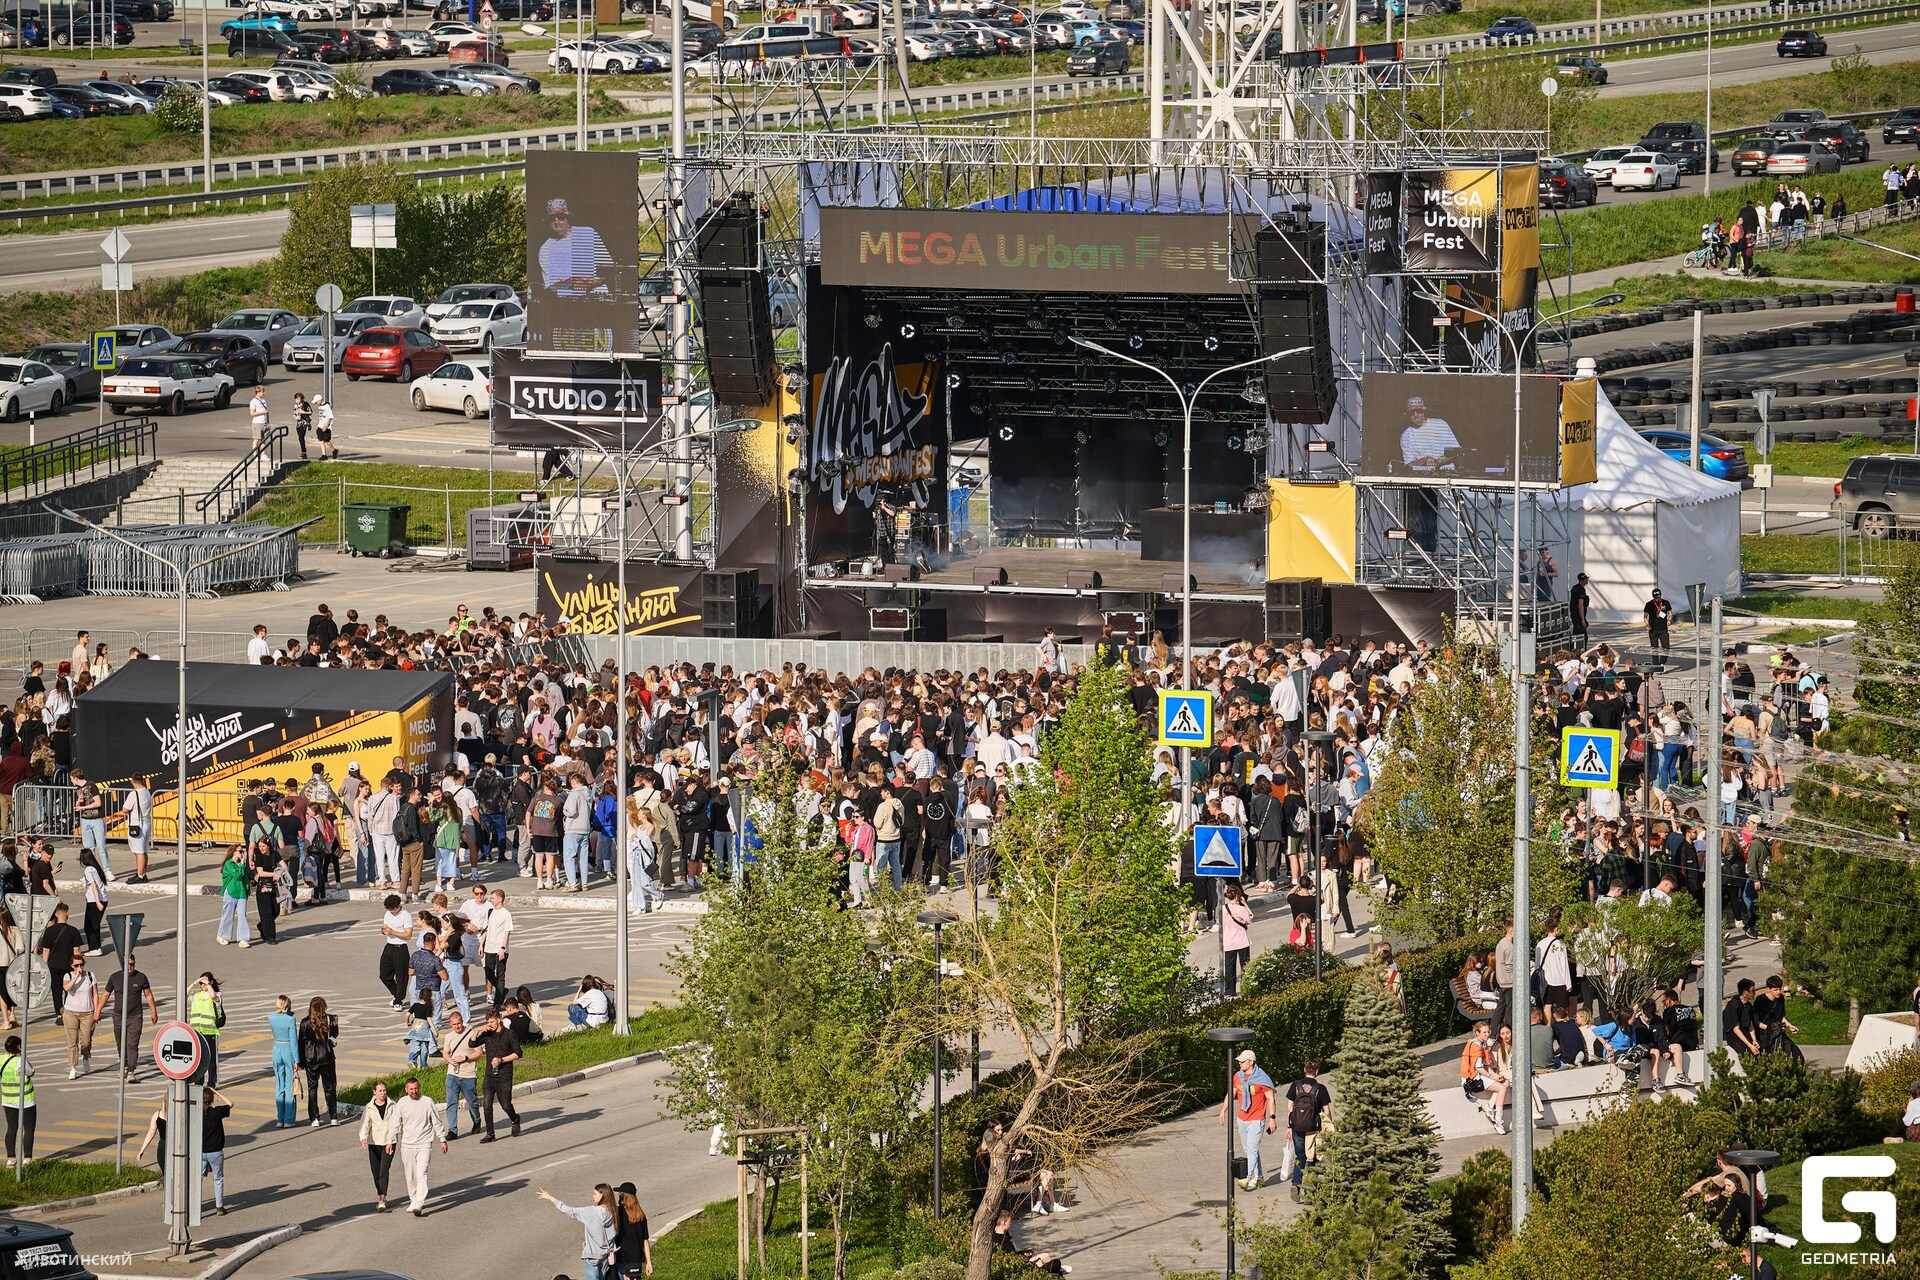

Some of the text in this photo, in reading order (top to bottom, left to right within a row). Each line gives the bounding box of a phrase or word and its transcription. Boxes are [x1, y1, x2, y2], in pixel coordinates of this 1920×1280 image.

[1369, 190, 1393, 211] MEGA
[1423, 189, 1483, 207] MEGA
[1368, 214, 1392, 232] Urban
[1424, 210, 1483, 229] Urban
[1368, 237, 1386, 254] Fest
[1423, 232, 1465, 250] Fest
[859, 230, 1227, 271] MEGA Urban Fest
[521, 387, 637, 412] STUDIO 21
[409, 717, 437, 736] MEGA
[286, 740, 301, 749] MEGA
[409, 740, 437, 757] Urban
[408, 760, 429, 776] Fest
